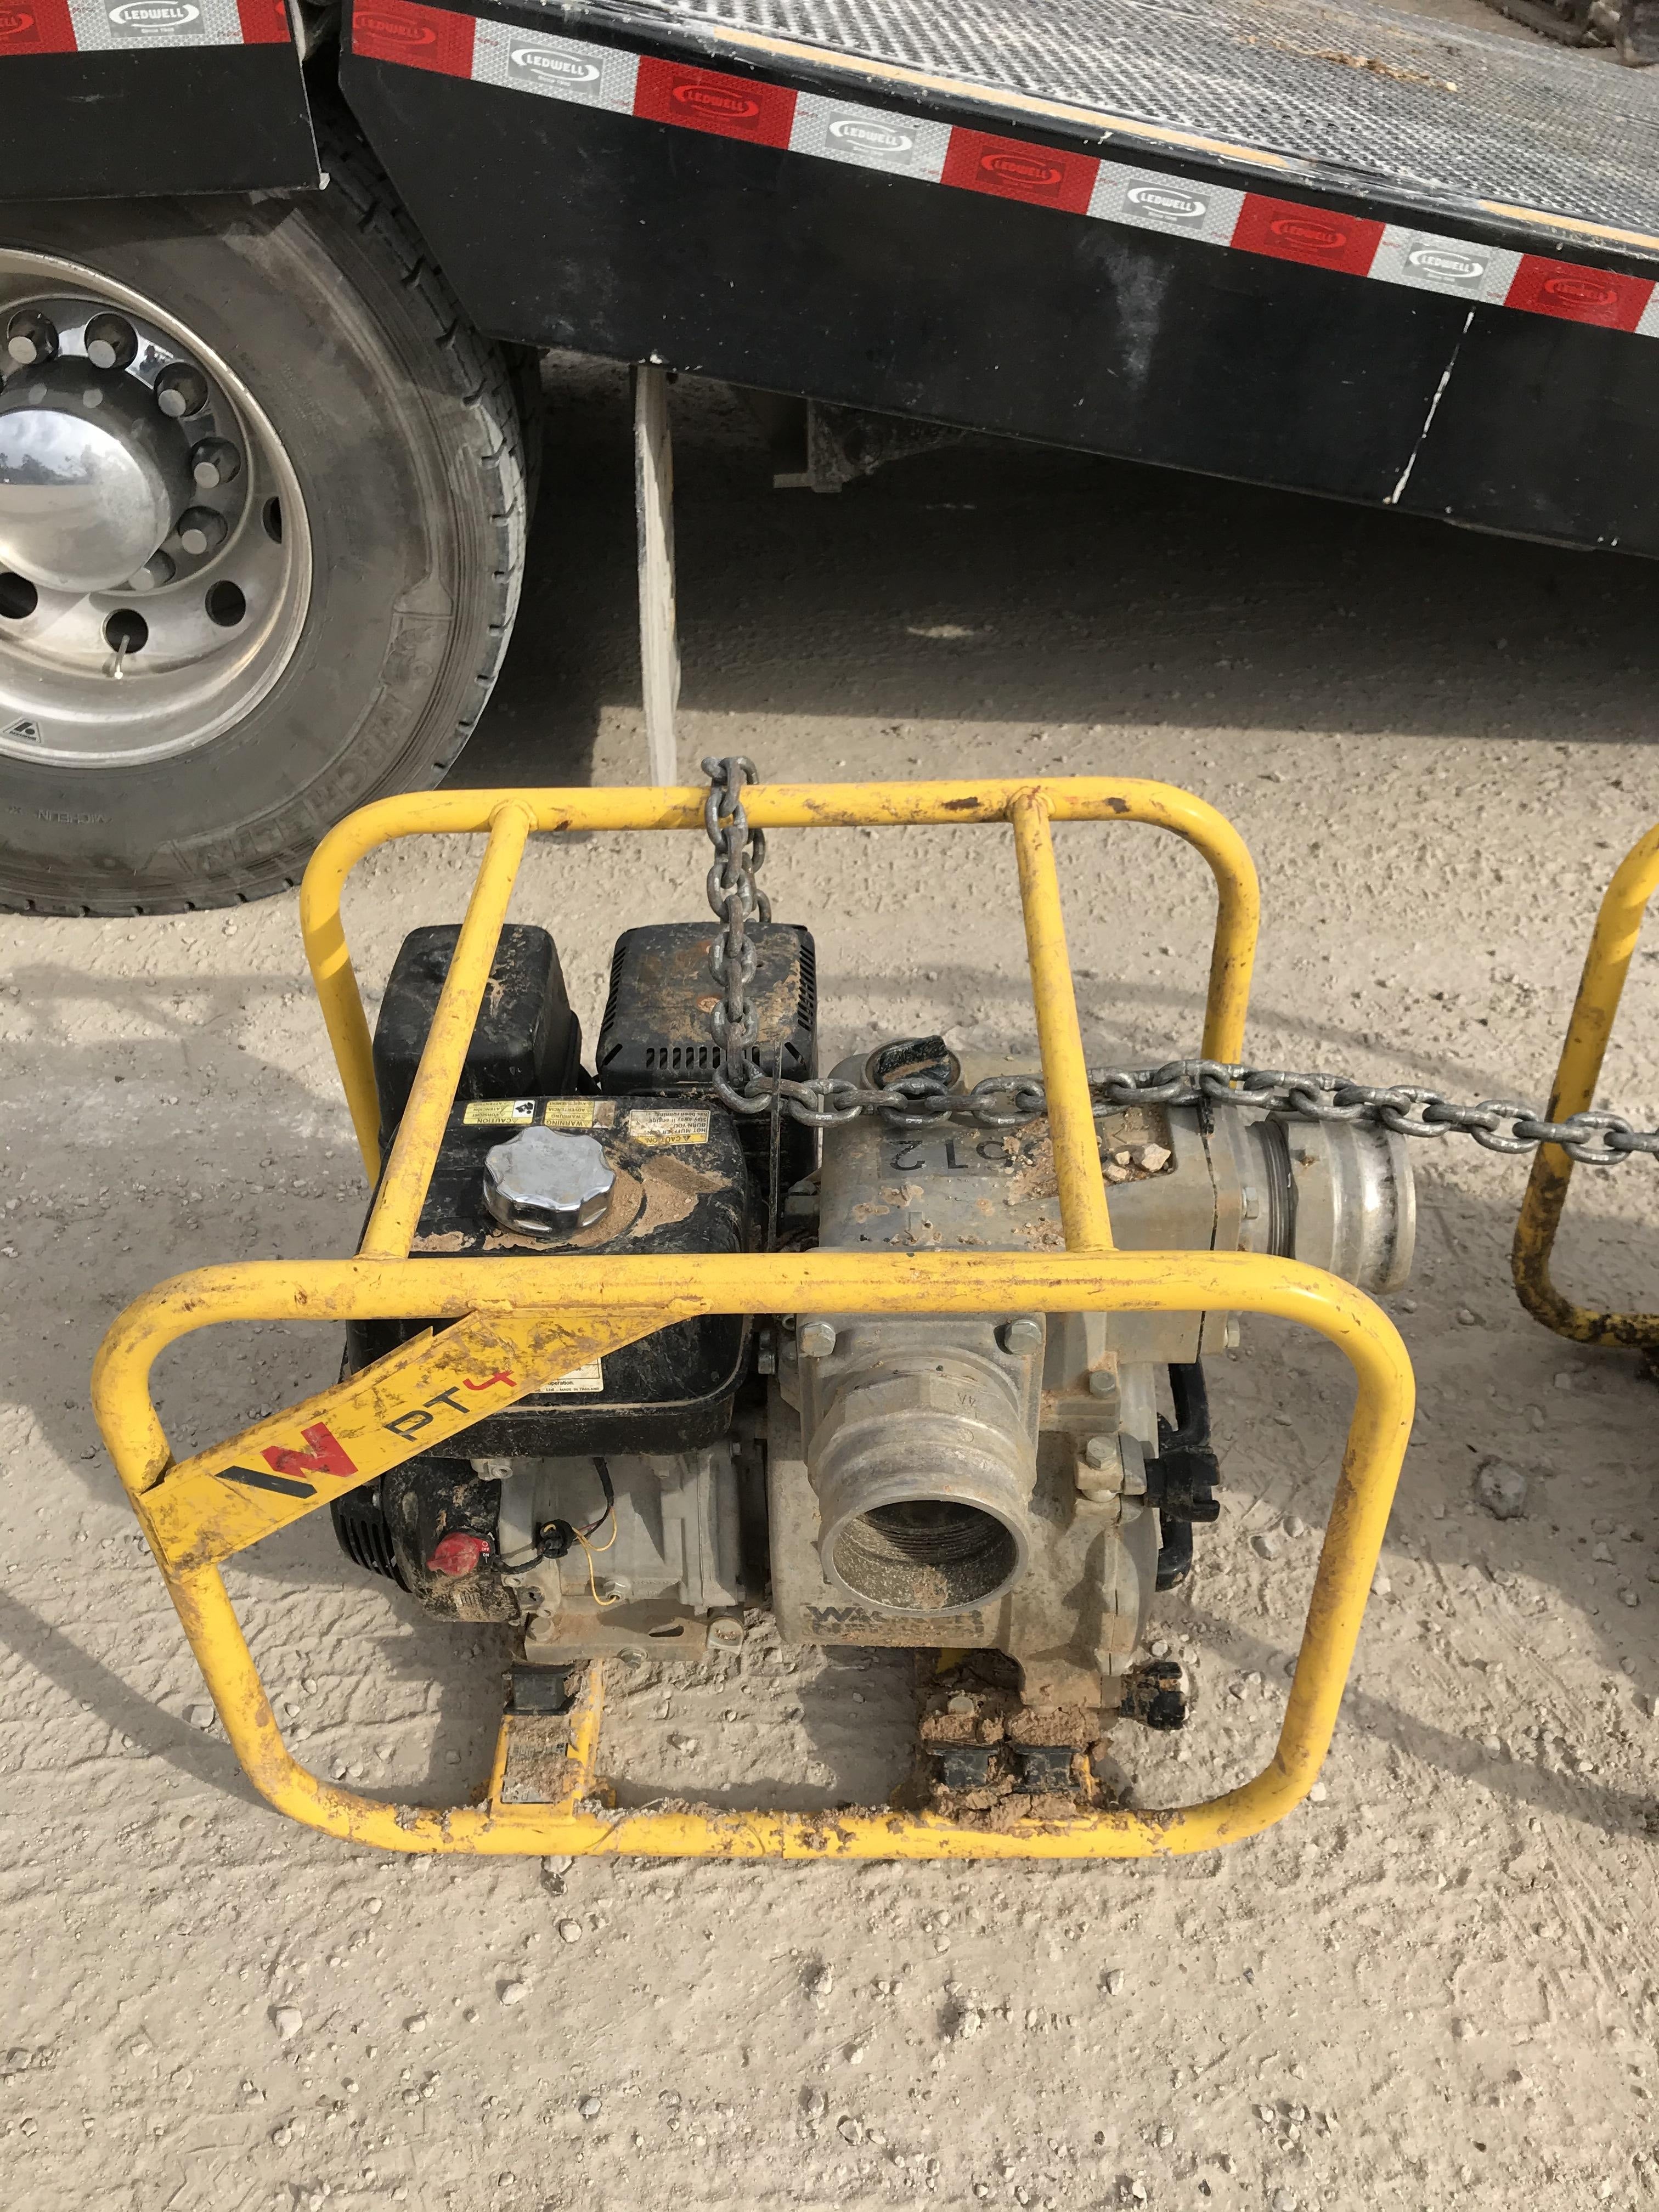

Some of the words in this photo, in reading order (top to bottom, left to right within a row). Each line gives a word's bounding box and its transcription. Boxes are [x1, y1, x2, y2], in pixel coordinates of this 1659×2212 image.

[124, 8, 184, 20] LEDWELL
[526, 54, 584, 76] LEDWELL
[687, 90, 745, 112] LEDWELL
[843, 126, 898, 145] LEDWELL
[994, 160, 1048, 179] LEDWELL
[1141, 192, 1193, 211] LEDWELL
[1420, 255, 1471, 273] LEDWELL
[646, 1136, 681, 1144] CAUTON
[385, 1368, 516, 1441] PT4
